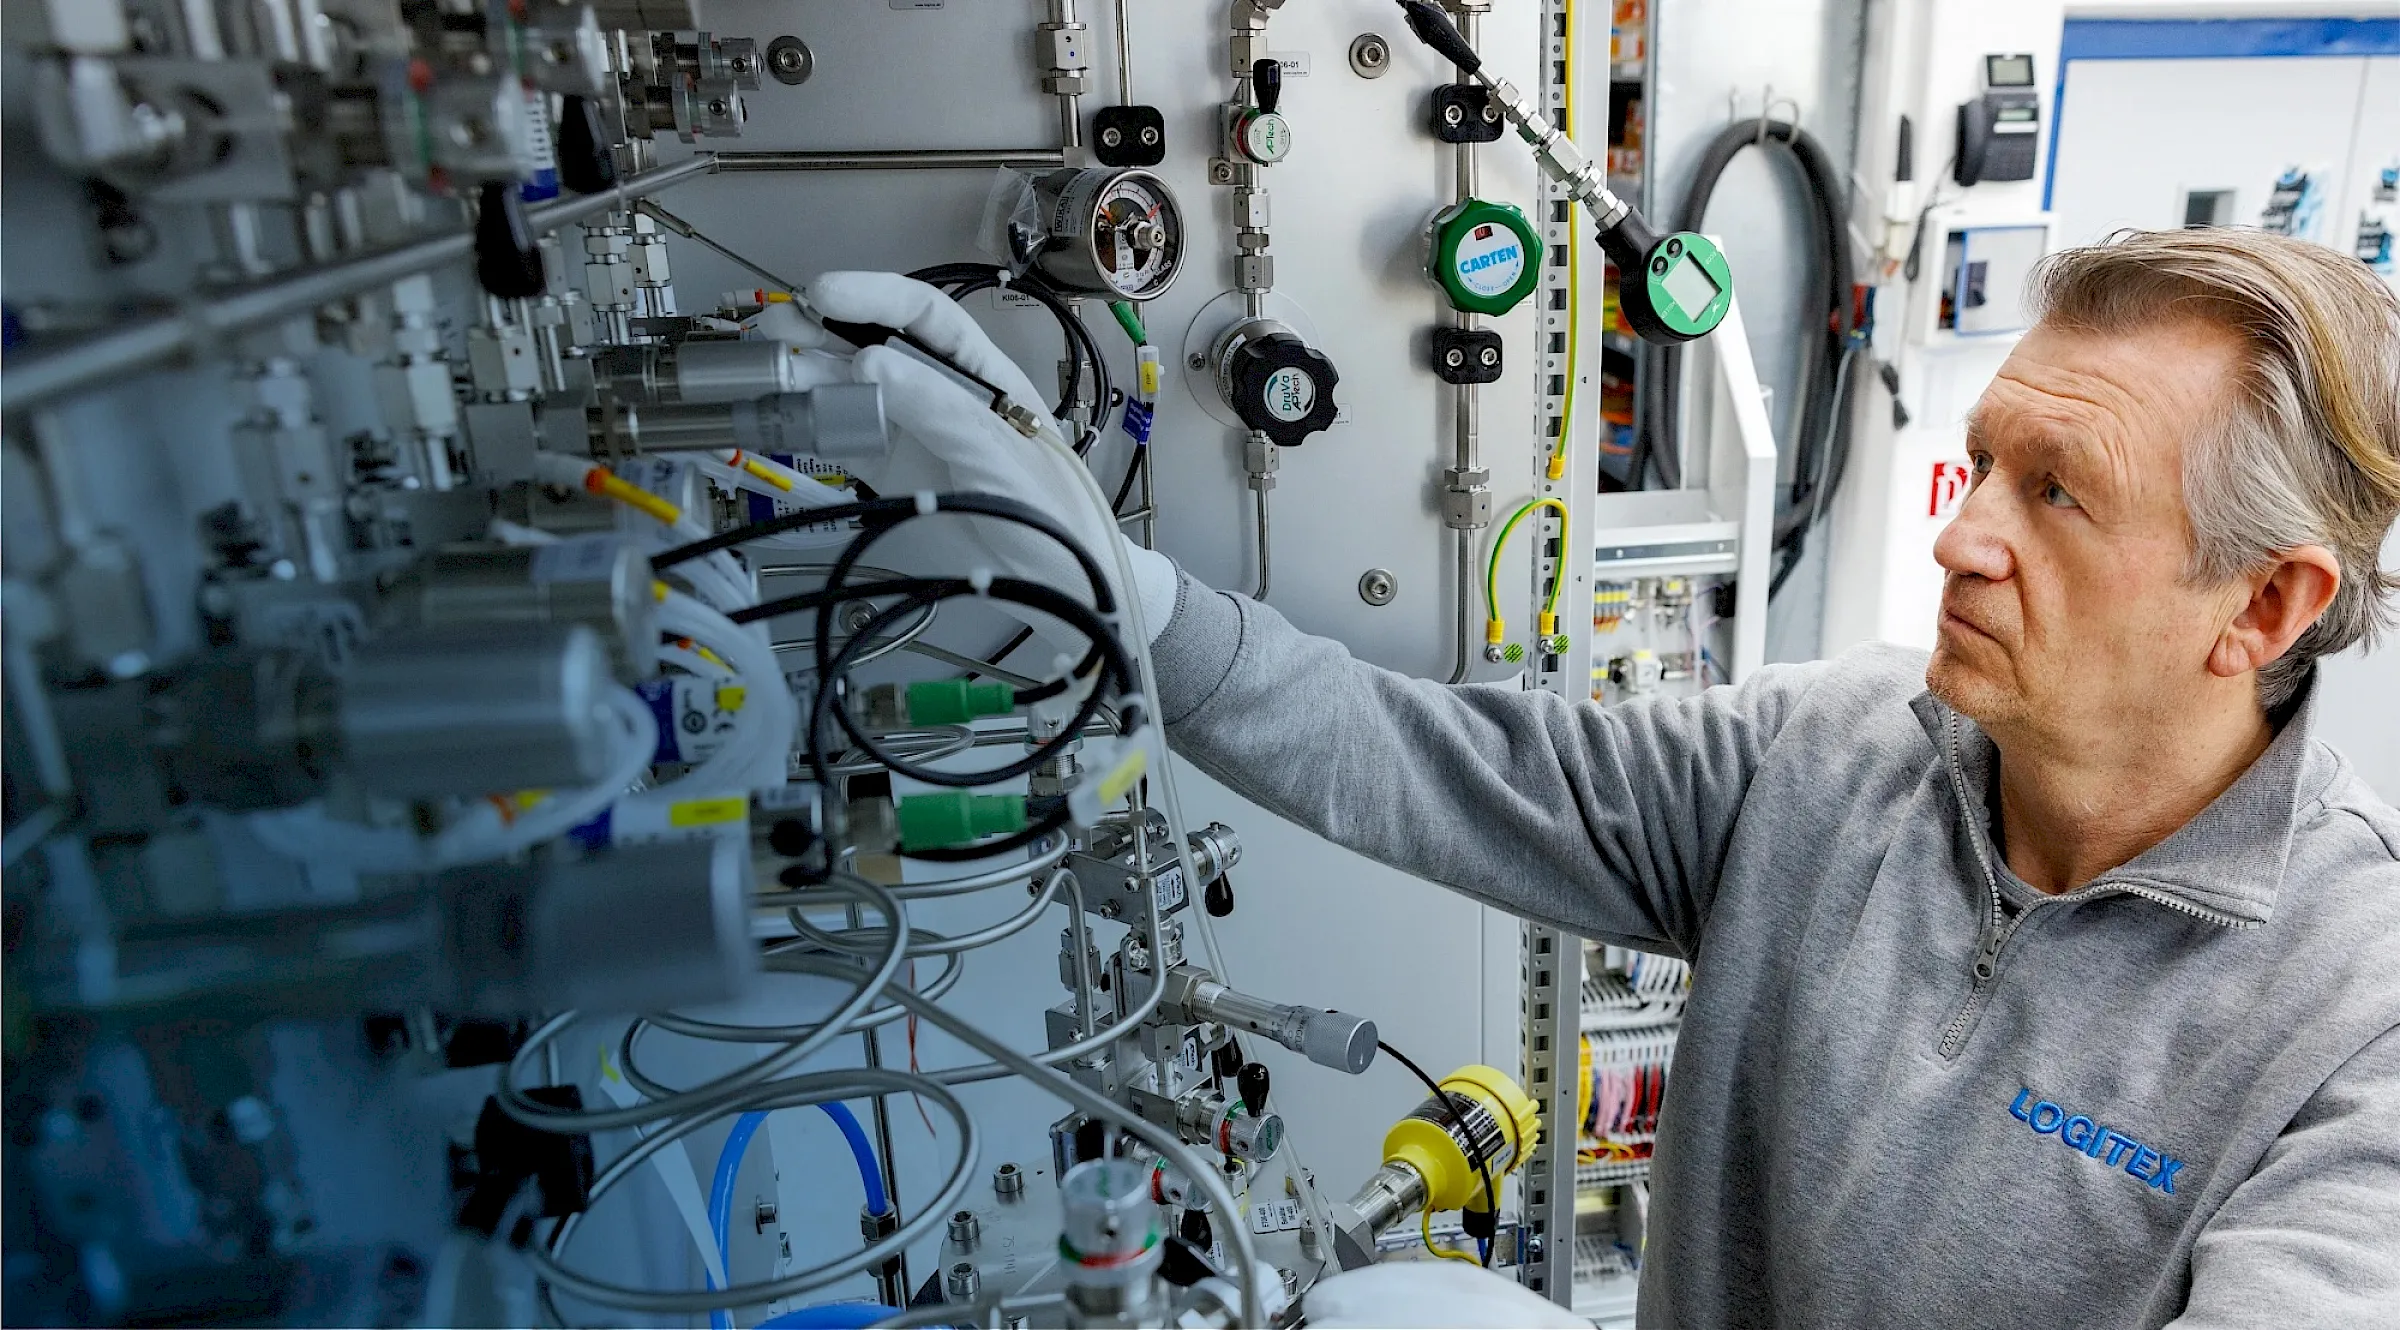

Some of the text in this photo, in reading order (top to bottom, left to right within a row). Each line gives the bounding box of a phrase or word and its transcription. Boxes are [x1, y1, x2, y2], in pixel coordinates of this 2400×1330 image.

[1460, 245, 1518, 274] CARTEN
[1282, 375, 1292, 411] DruVa
[2009, 1087, 2184, 1194] LOGITEX
